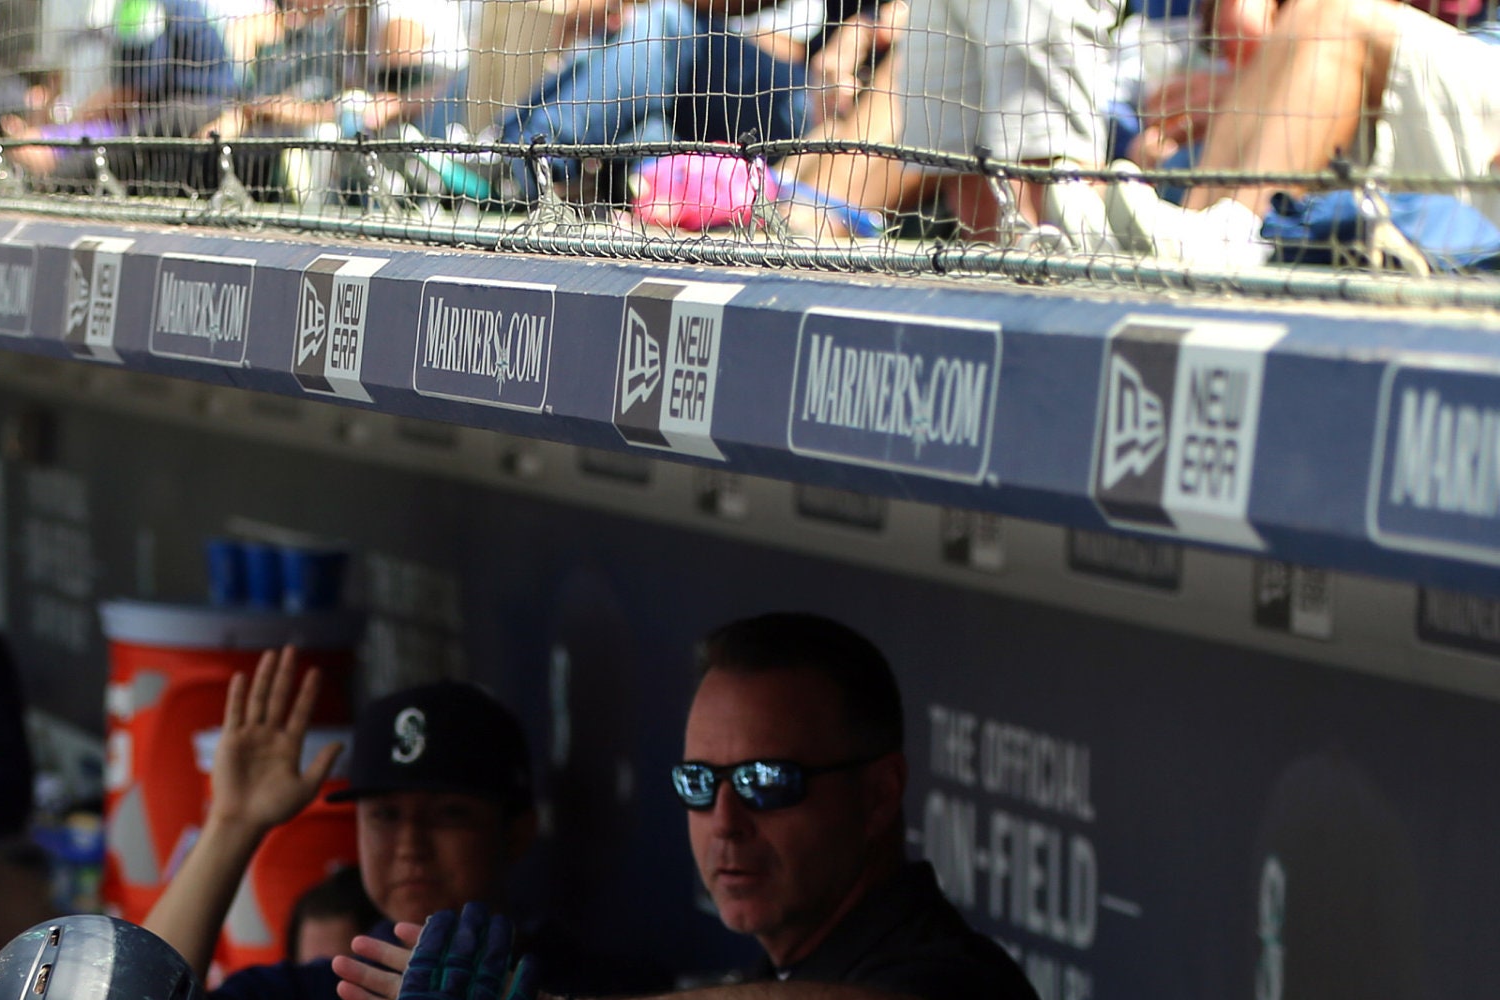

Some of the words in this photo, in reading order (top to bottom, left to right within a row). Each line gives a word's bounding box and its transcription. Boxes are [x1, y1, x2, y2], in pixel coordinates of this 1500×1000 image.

[335, 283, 364, 326] NEW
[331, 327, 359, 371] ERA
[674, 316, 715, 368] NEW
[669, 369, 708, 422] ERA
[1188, 367, 1252, 430] NEW
[1179, 433, 1238, 499] ERA
[392, 706, 426, 763] S
[929, 703, 978, 788] THE
